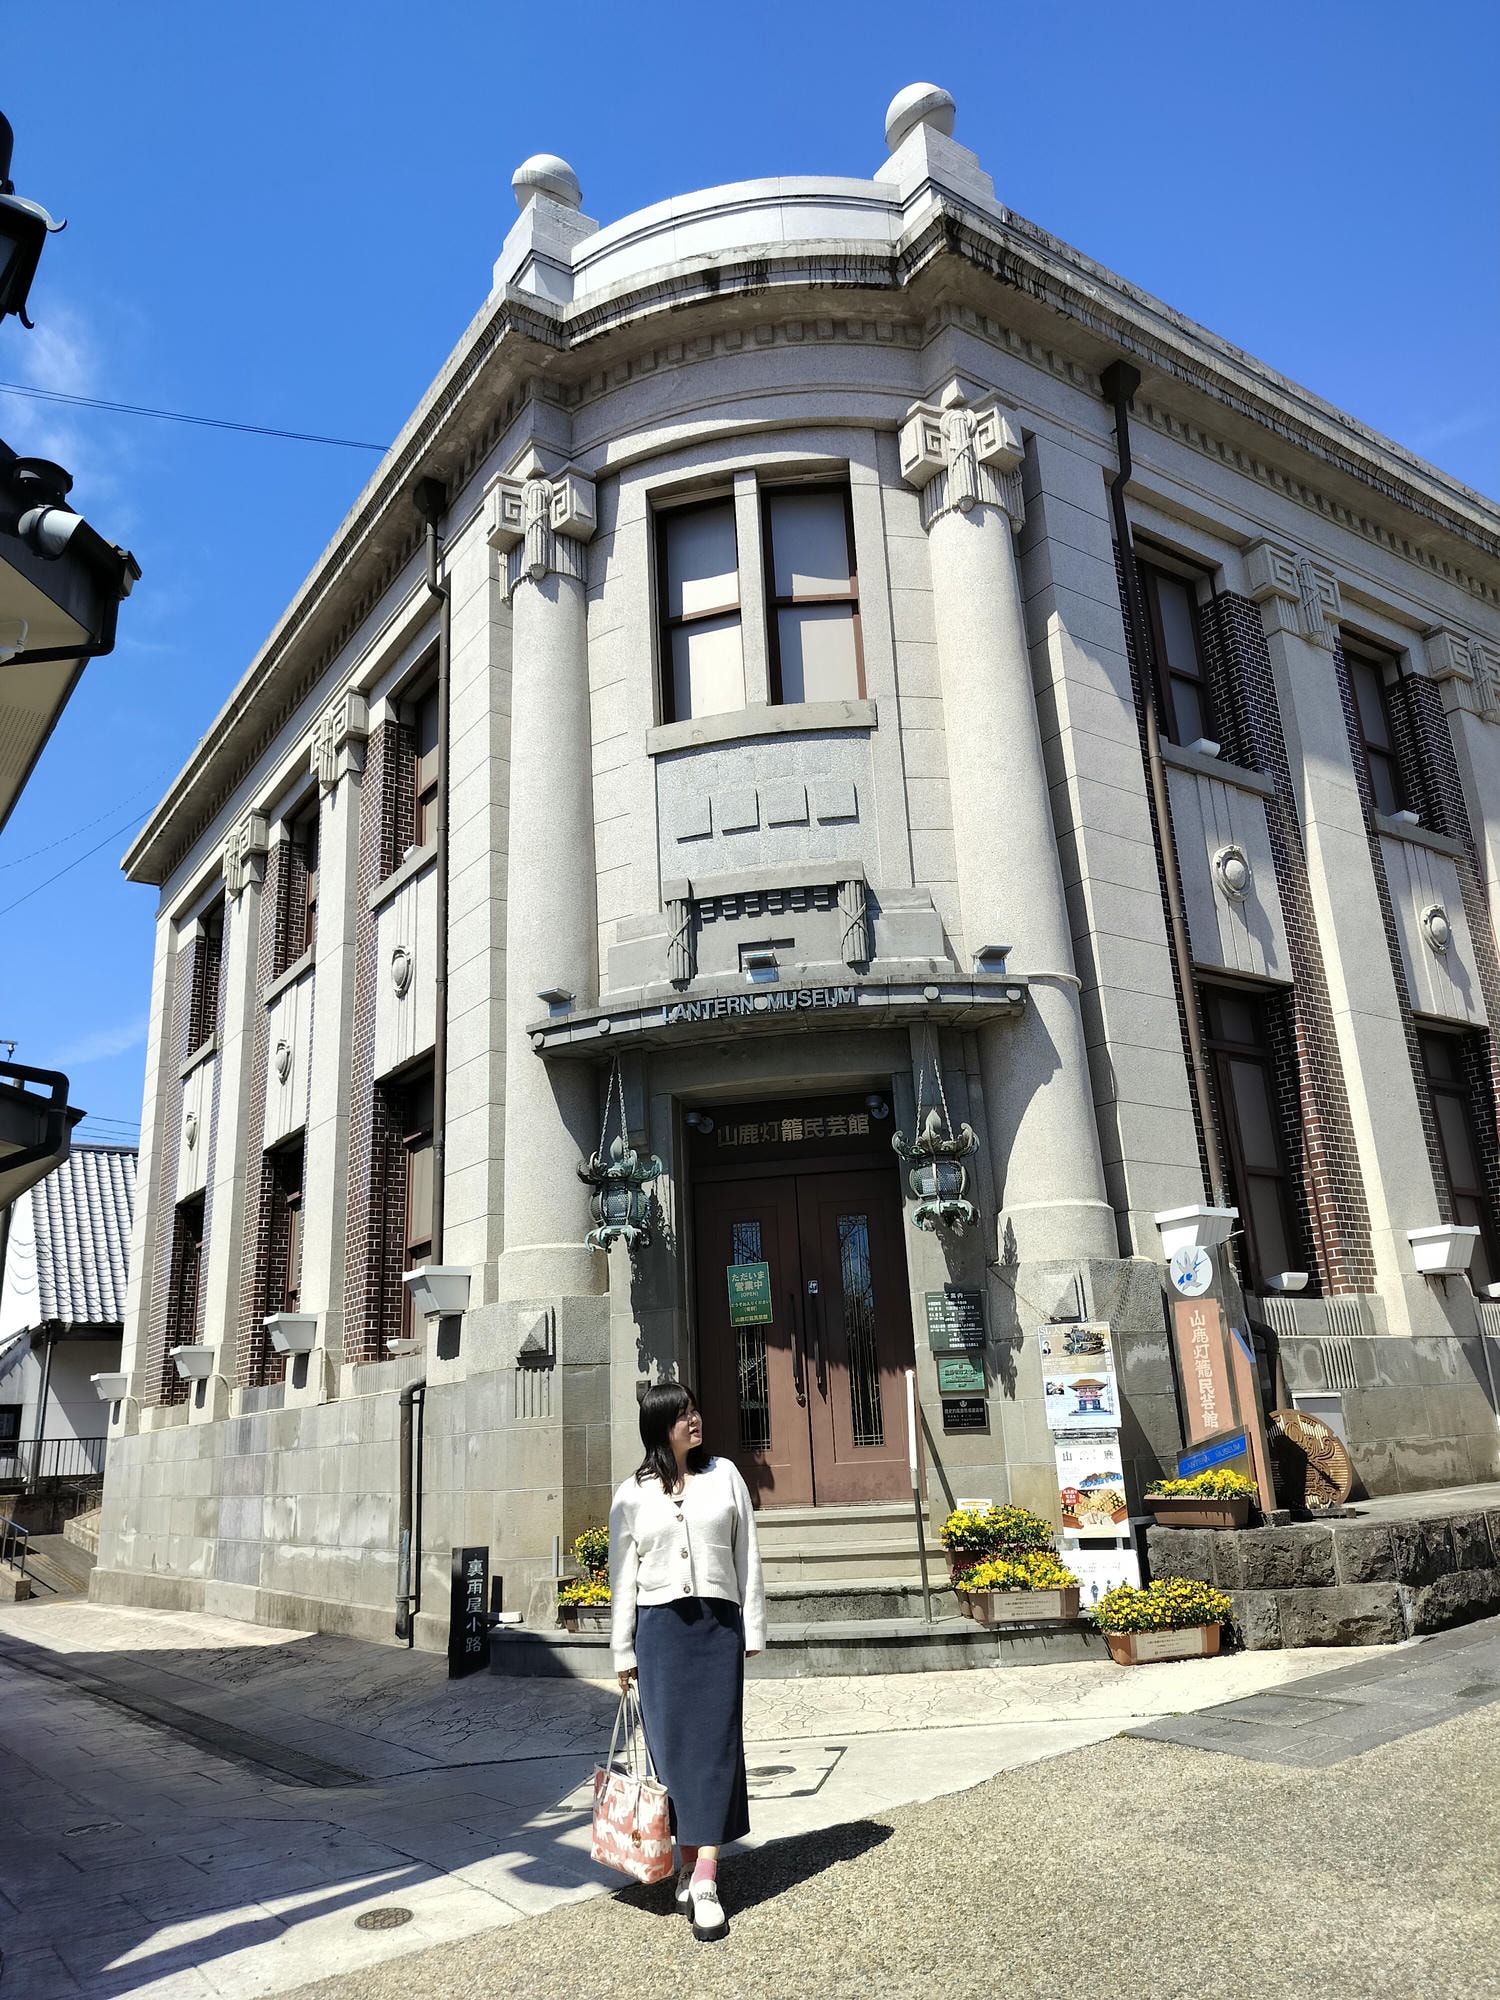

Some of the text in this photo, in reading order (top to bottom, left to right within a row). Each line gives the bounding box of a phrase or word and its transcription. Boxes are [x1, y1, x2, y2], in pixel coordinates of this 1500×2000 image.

[662, 987, 855, 1022] LANTERN MUSEUM
[718, 1114, 869, 1147] 山鹿灯籠民芸館
[731, 1270, 765, 1282] ただいま
[735, 1280, 763, 1292] 営業中
[1189, 1309, 1218, 1428] 山鹿灯籠民芸館
[466, 1559, 483, 1653] 裏雨屋小路
